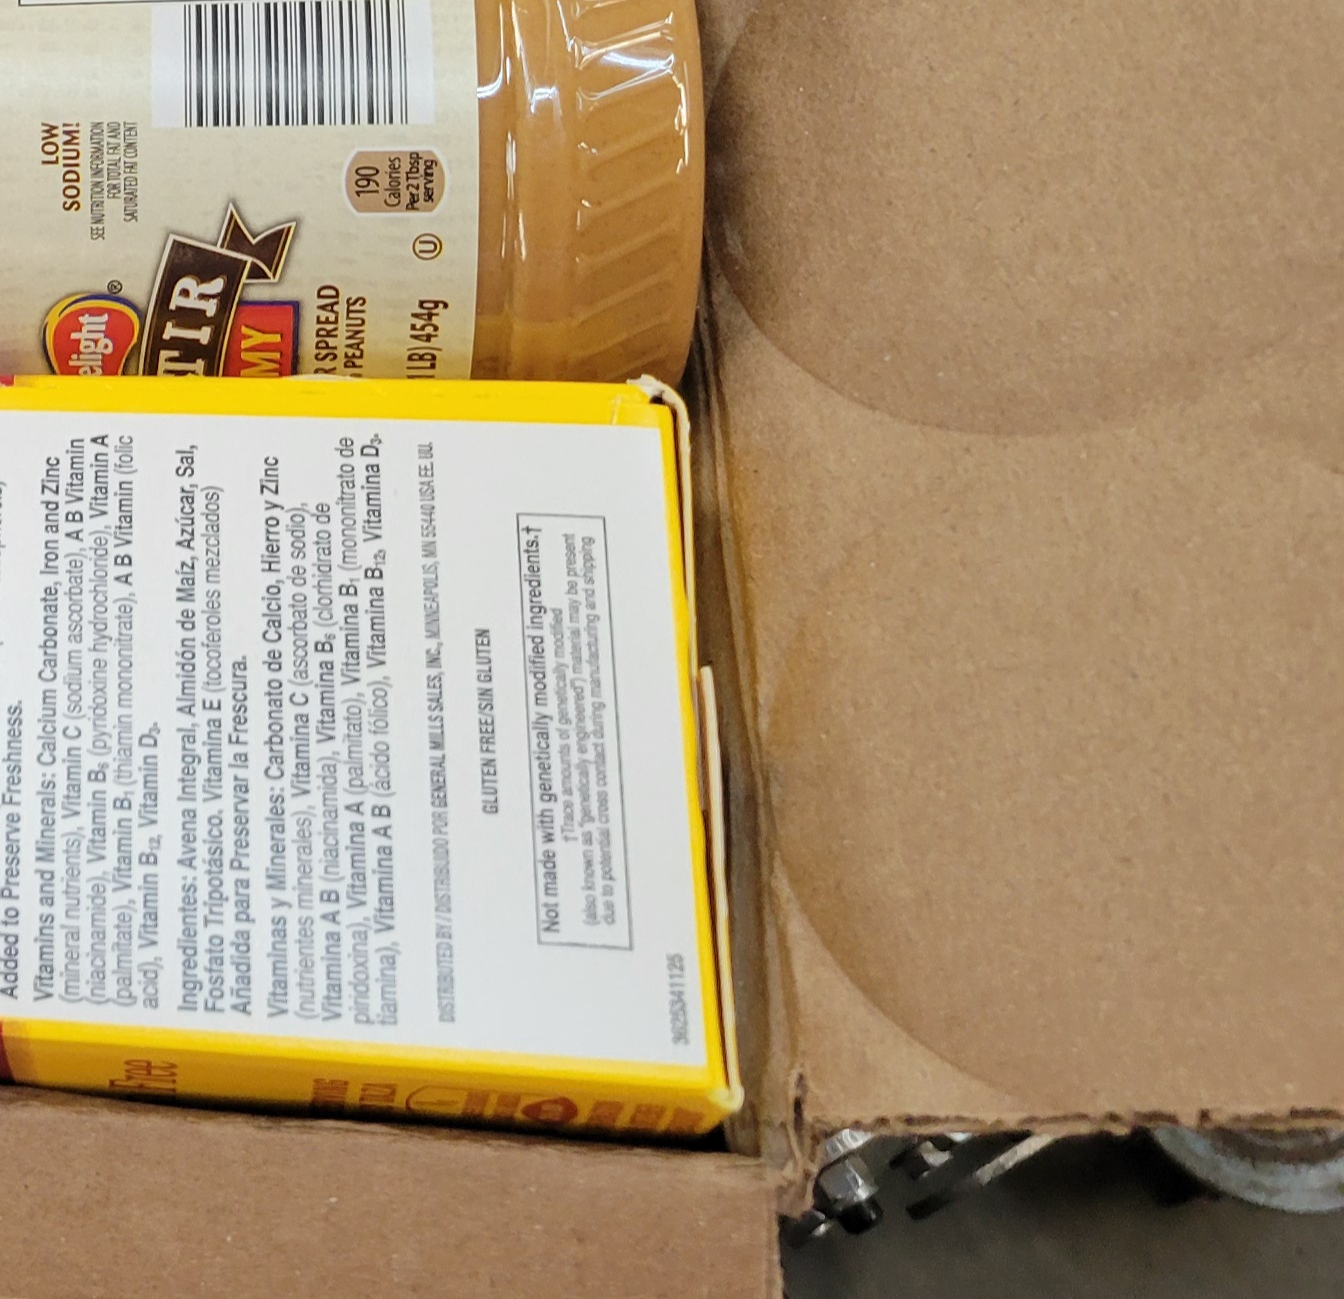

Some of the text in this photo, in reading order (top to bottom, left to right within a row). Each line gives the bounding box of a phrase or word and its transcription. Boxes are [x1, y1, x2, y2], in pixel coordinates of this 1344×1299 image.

[40, 122, 61, 166] LOW
[62, 121, 81, 212] SODIUM!
[107, 121, 121, 199] FOR TOTAL FAT AND
[123, 121, 138, 222] SATURATED FAT CONTENT
[90, 121, 105, 240] SEE NUTRITION INFORMATION
[355, 166, 380, 197] 190
[384, 157, 401, 207] Calories
[406, 152, 423, 211] Per 2 Tbsp
[420, 159, 437, 203] serving
[316, 285, 340, 361] SPREAD
[345, 296, 366, 368] PEANUTS
[411, 299, 449, 342] 454g
[527, 635, 552, 707] modified
[474, 628, 500, 815] GLUTEN FREE/SIN GLUTEN
[531, 713, 558, 803] genetically
[534, 808, 558, 844] with
[537, 849, 560, 899] made
[539, 903, 561, 933] Not
